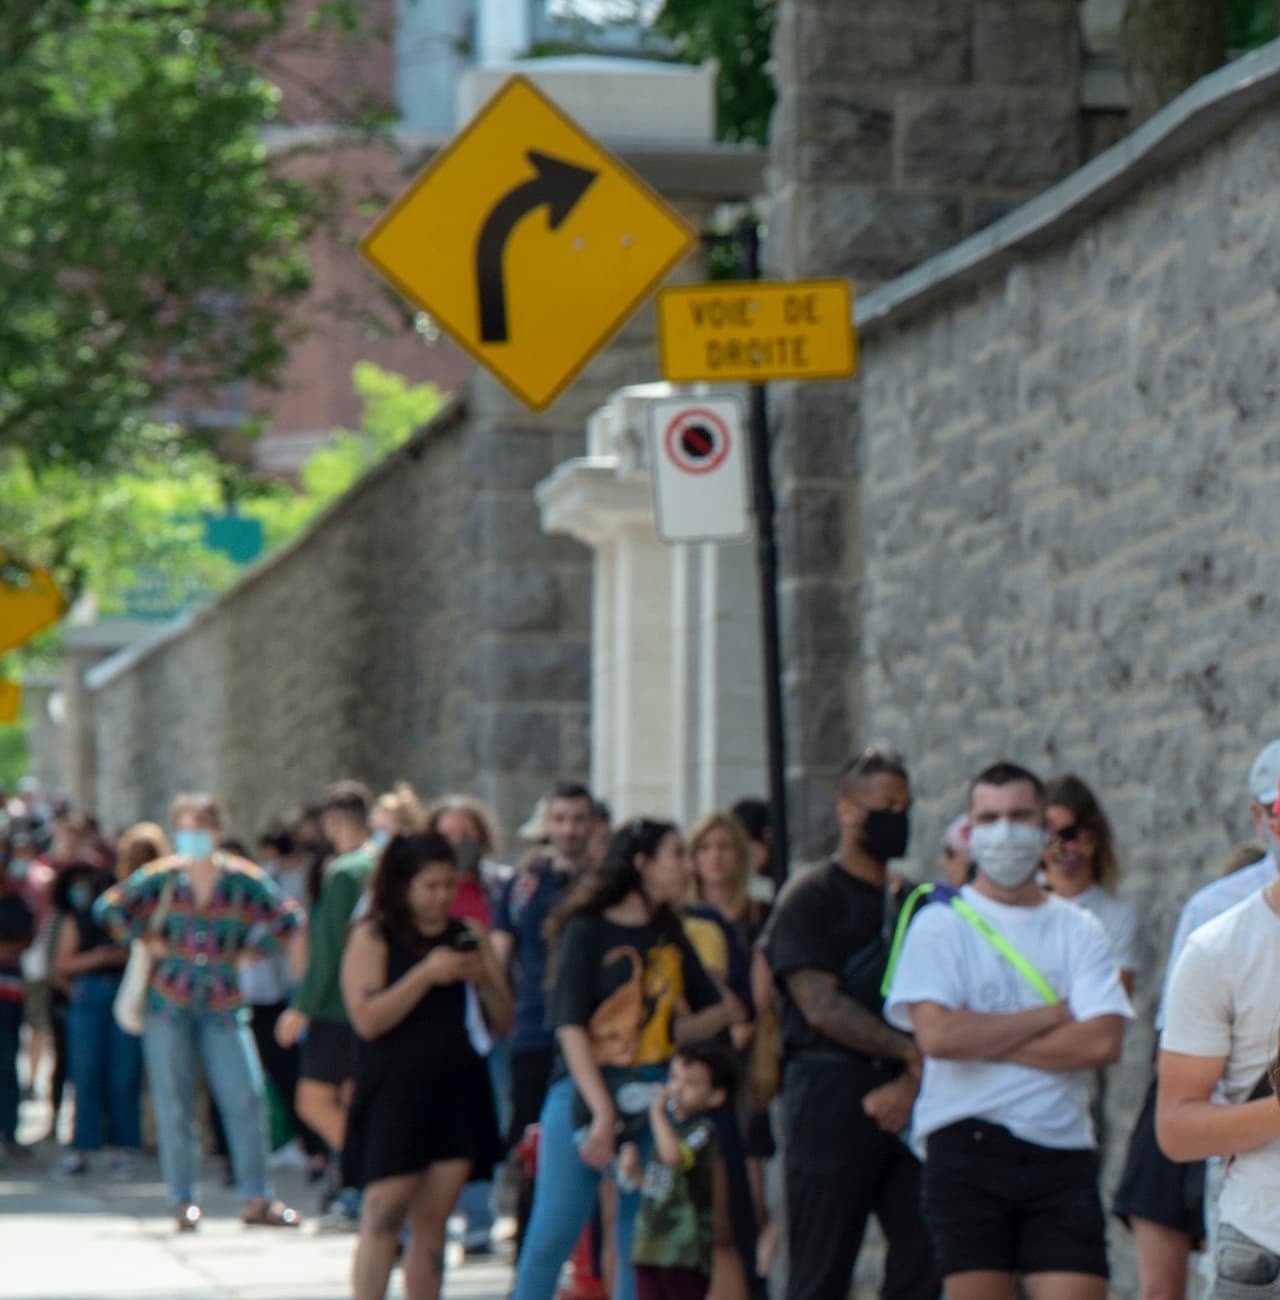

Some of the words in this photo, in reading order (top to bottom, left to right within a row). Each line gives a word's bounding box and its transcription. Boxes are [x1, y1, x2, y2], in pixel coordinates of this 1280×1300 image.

[688, 297, 753, 329] VOIE
[784, 293, 820, 325] DE
[706, 334, 808, 370] DROITE
